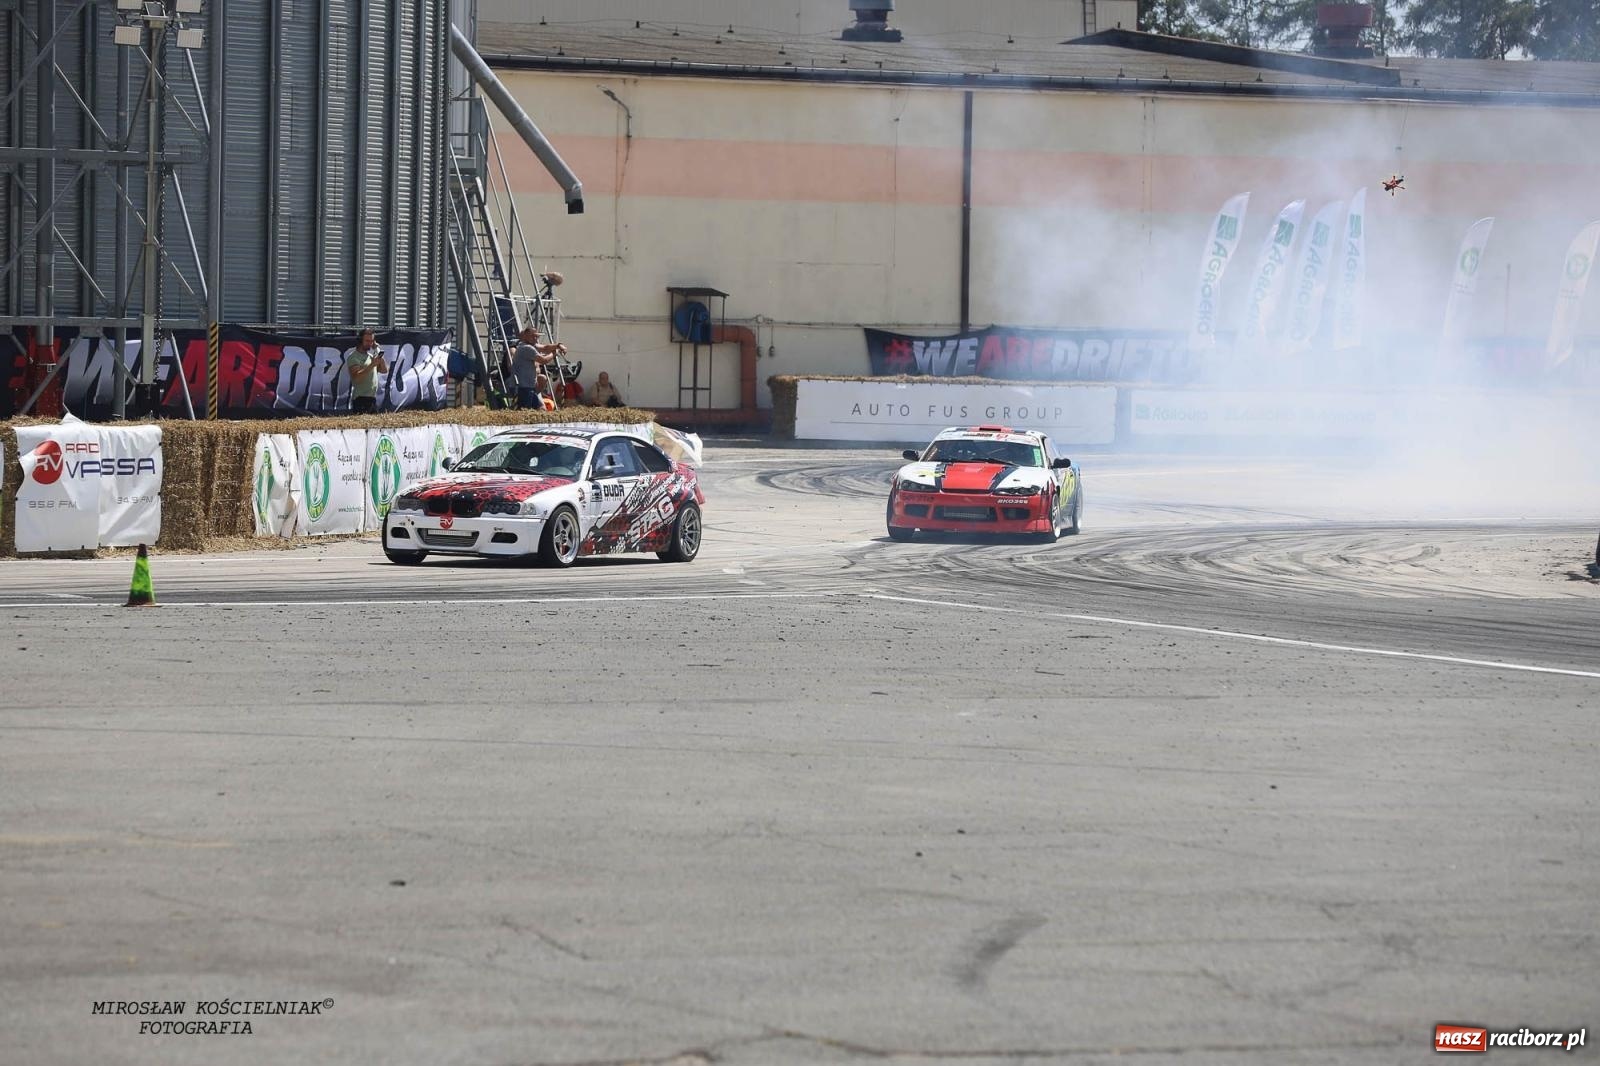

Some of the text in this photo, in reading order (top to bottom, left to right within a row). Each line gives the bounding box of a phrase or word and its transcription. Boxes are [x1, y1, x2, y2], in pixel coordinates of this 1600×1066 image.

[851, 403, 1063, 420] AUTO FUS GROUP
[66, 457, 156, 478] VASSA
[628, 494, 675, 543] STAG
